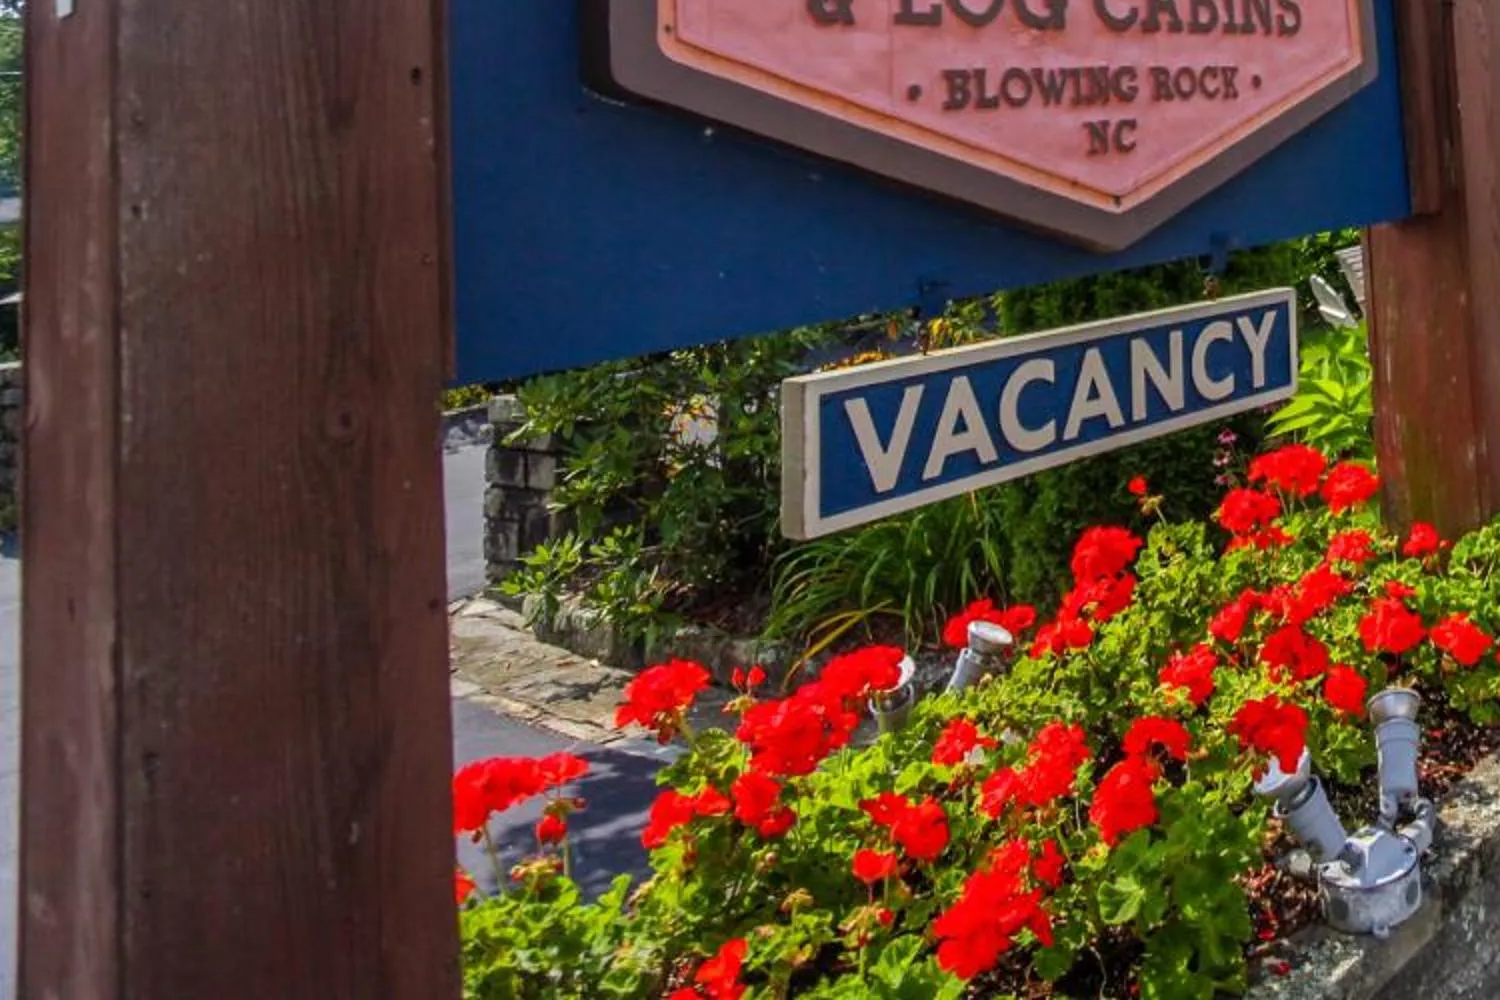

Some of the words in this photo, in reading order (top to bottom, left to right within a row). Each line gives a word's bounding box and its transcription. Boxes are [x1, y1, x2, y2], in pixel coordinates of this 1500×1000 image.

[941, 65, 1139, 111] BLOWING
[1150, 65, 1241, 101] ROCK
[1082, 119, 1138, 155] NC
[844, 310, 1277, 494] VACANCY
